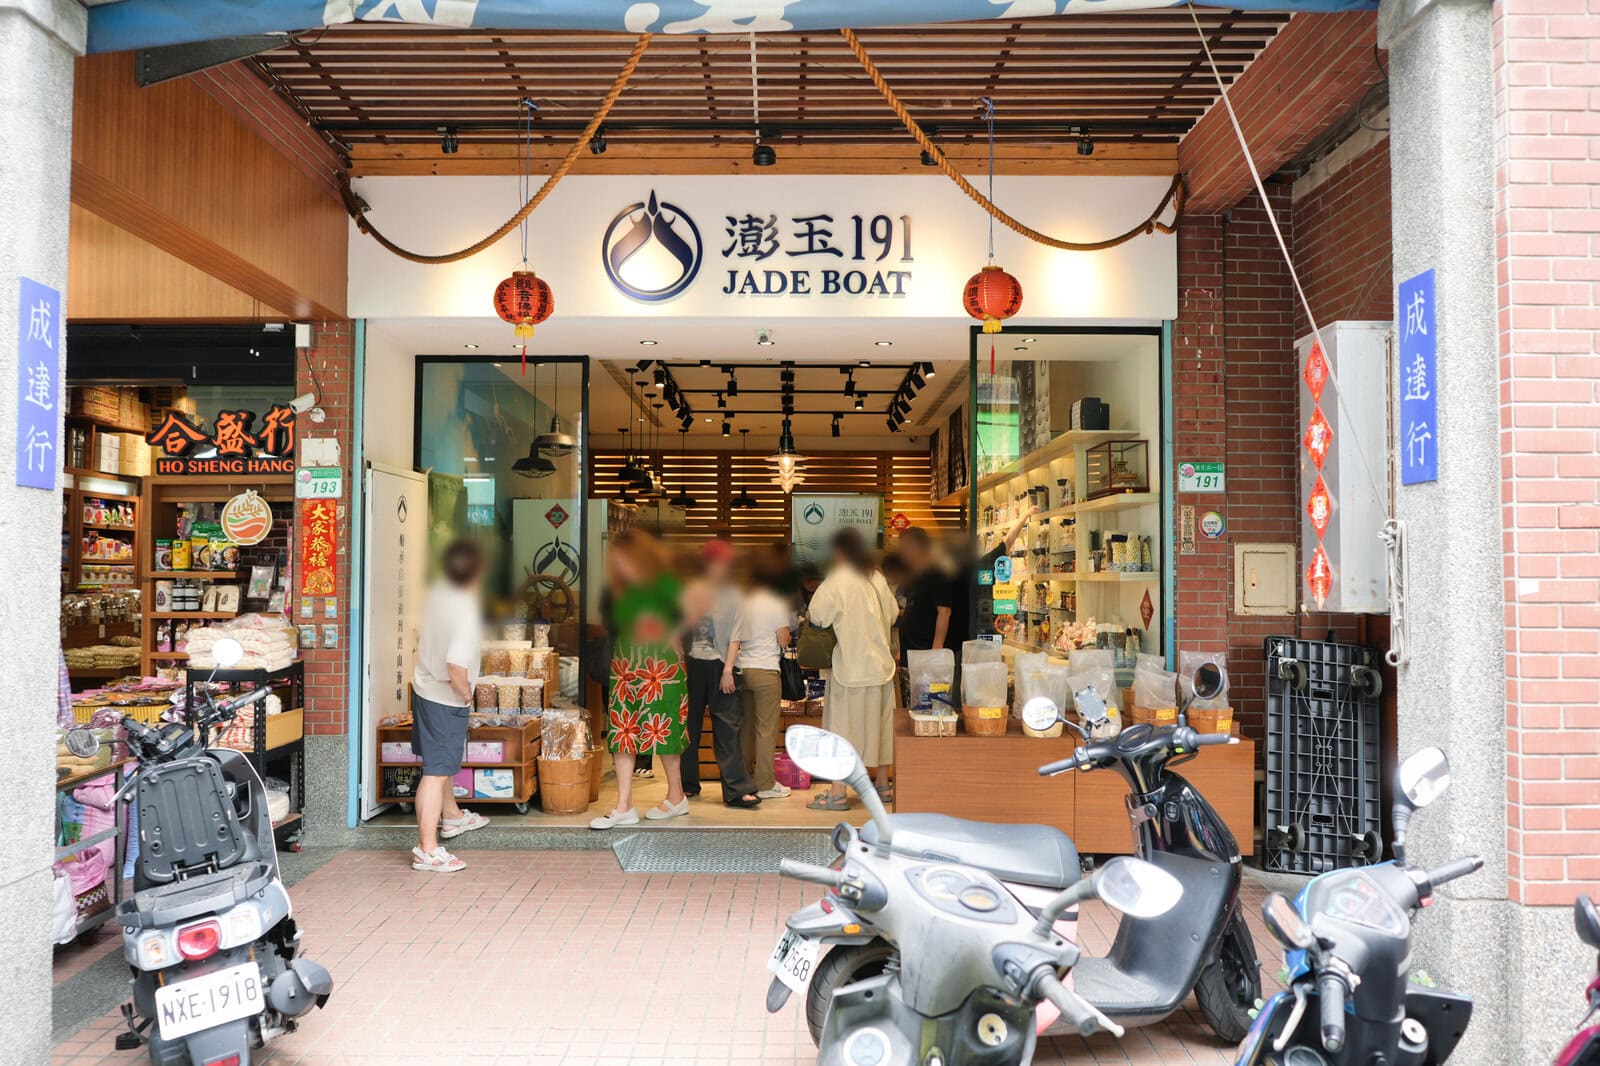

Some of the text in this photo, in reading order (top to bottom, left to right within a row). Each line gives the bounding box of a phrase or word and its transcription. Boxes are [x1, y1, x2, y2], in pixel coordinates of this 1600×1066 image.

[722, 213, 914, 262] 澎玉191
[722, 269, 912, 296] JADE BOAT
[24, 298, 53, 473] 成達行
[1403, 289, 1432, 468] 成達行
[149, 405, 296, 455] 合盛行
[159, 460, 295, 473] HO SHENG HANG
[312, 481, 337, 494] 193
[1195, 475, 1219, 488] 191
[162, 977, 257, 1026] NXE-1918
